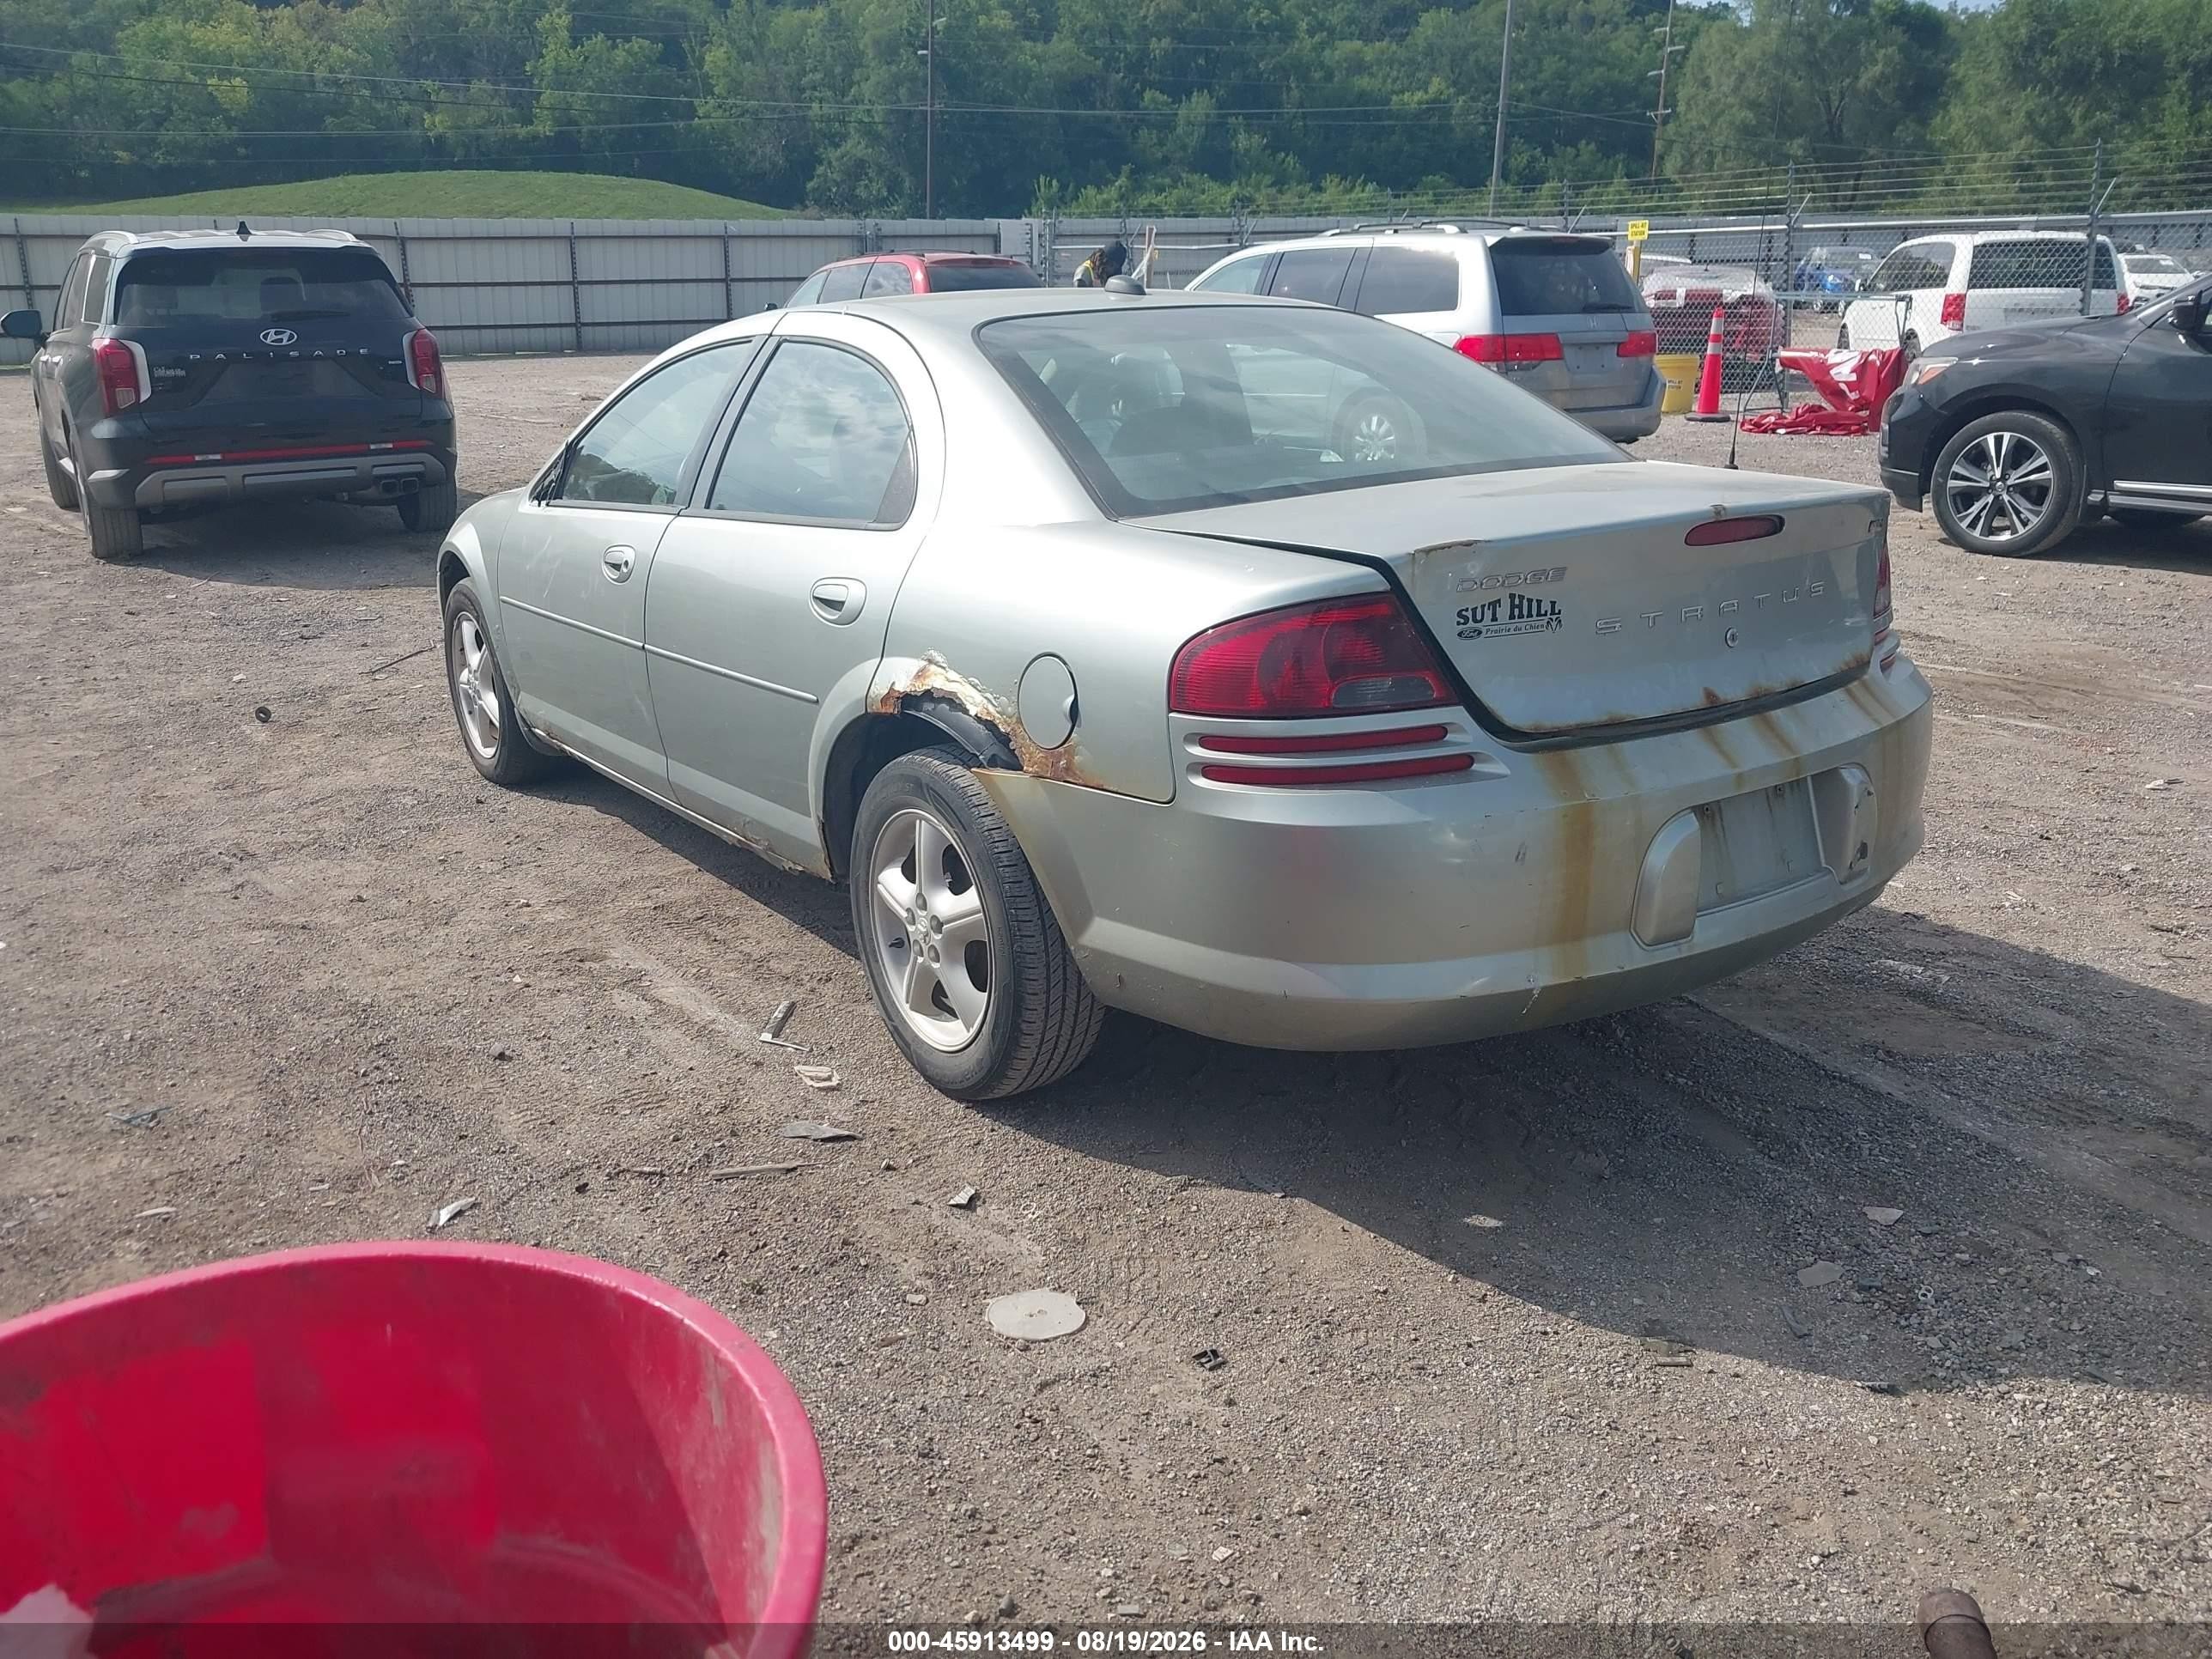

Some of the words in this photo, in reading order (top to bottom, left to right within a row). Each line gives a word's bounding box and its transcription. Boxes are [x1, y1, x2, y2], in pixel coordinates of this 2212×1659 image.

[190, 348, 370, 360] PALISADE
[1456, 567, 1567, 592] DODGE
[1456, 598, 1502, 626] SUT
[1508, 592, 1562, 620] HILL
[1595, 581, 1825, 635] STRATUS
[1486, 627, 1511, 635] Prairie
[1524, 623, 1545, 631] Chien
